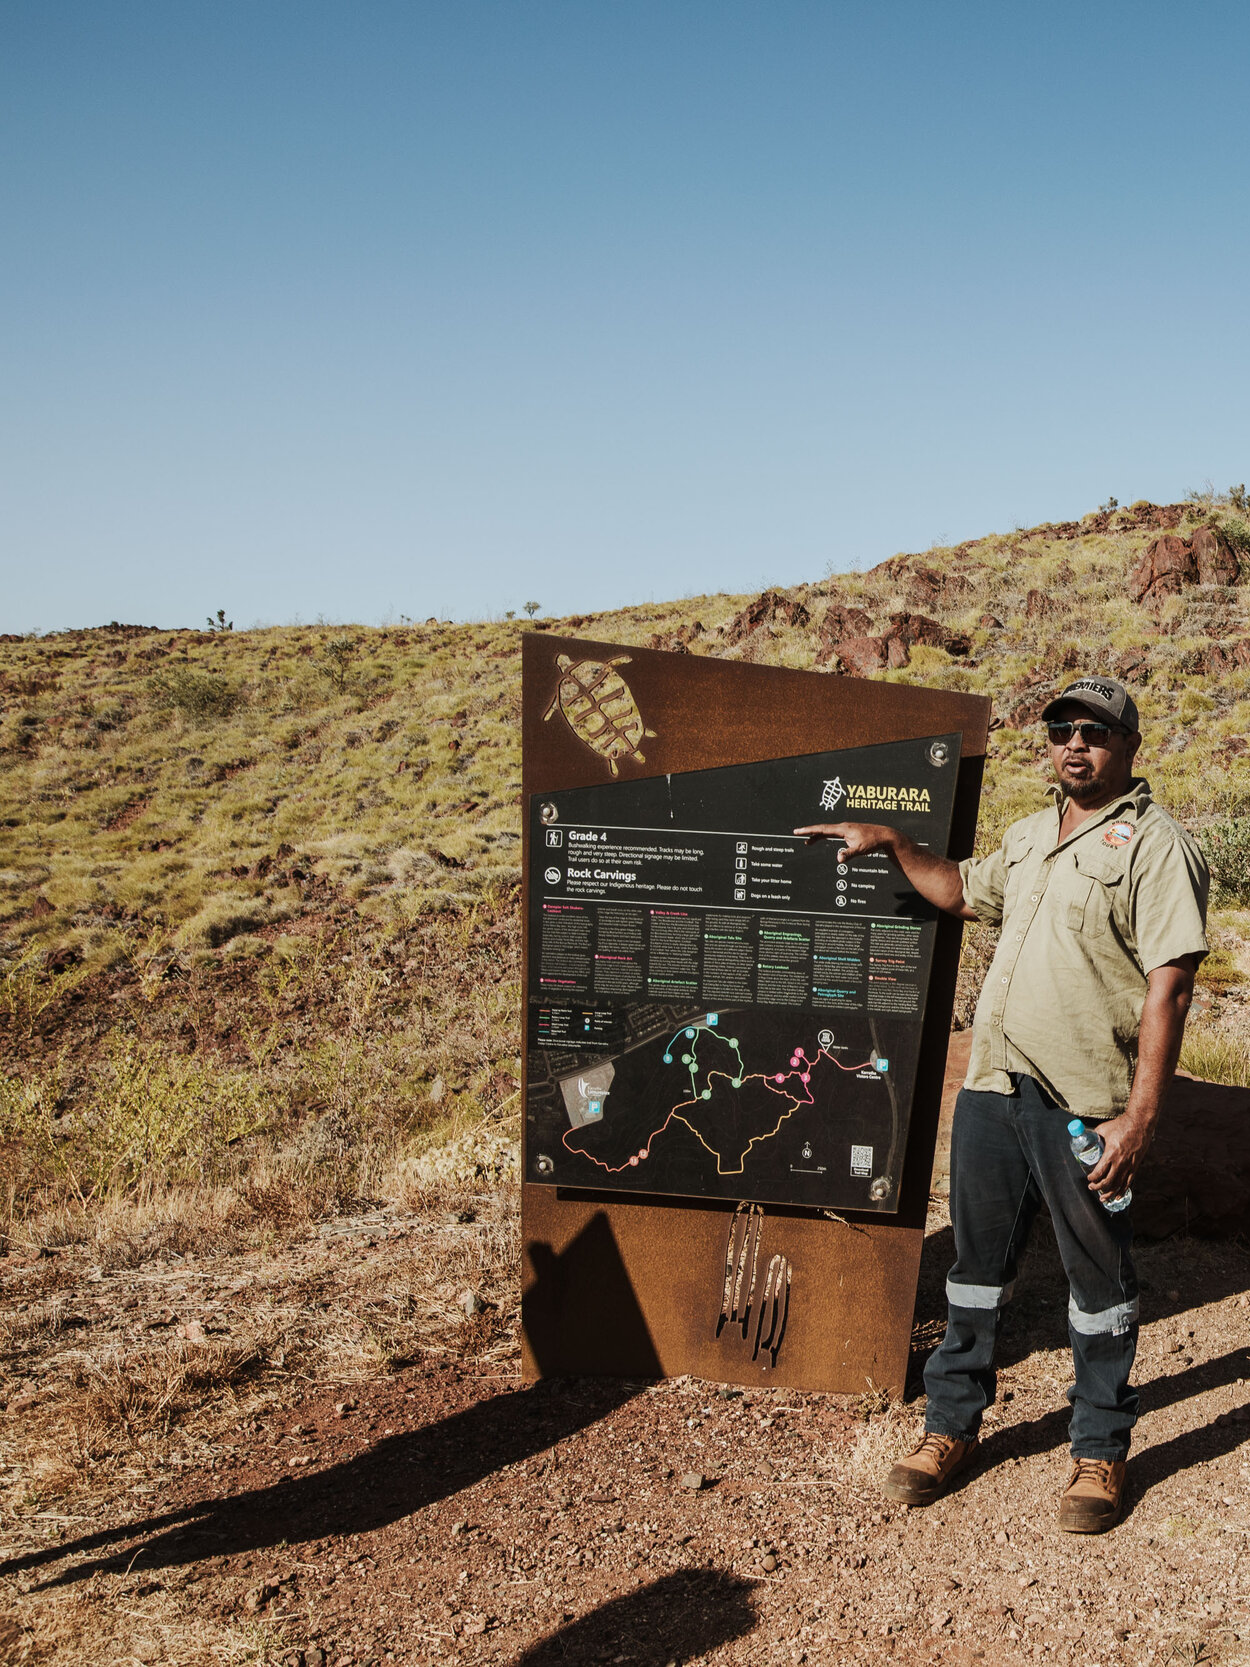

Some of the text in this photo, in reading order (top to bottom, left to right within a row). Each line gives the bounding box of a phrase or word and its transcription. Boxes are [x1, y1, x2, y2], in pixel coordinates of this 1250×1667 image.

[846, 784, 930, 802] YABURARA
[846, 799, 930, 812] HERITAGE TRAIL
[568, 830, 607, 842] Grade 4
[568, 842, 596, 850] Bushwalking
[568, 868, 636, 883] Rock Carvings
